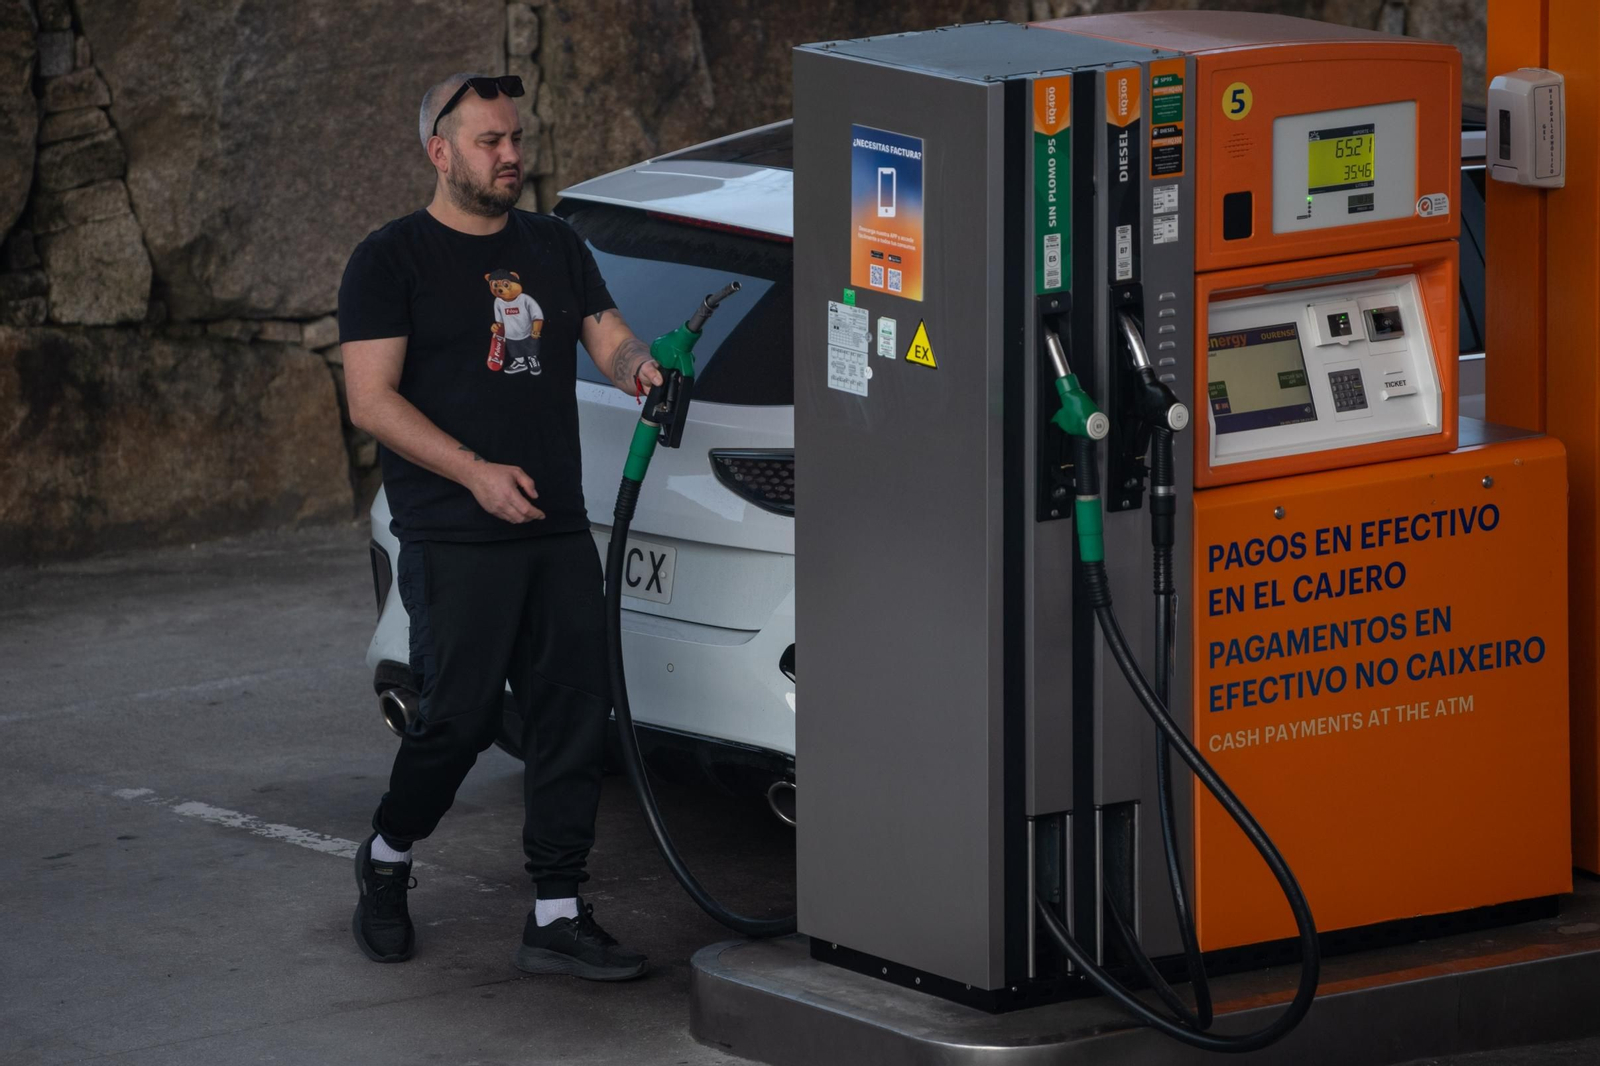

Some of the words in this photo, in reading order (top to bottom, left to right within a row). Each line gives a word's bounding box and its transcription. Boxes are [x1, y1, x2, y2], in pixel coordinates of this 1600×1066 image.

[1231, 89, 1246, 114] 5
[853, 138, 890, 153] ¿NECESITAS
[890, 146, 922, 160] FACTURA?
[1048, 138, 1056, 153] 95
[1119, 130, 1128, 182] DIESEL
[1048, 158, 1056, 202] PLOMO
[1048, 206, 1056, 227] SIN
[1048, 255, 1057, 263] E5
[1119, 246, 1128, 254] B7
[1207, 333, 1247, 349] nergy
[1261, 329, 1295, 340] OURENSE
[914, 345, 930, 362] EX
[1385, 380, 1406, 388] TICKET
[1208, 532, 1307, 572] PAGOS
[1315, 525, 1352, 556] EN
[1360, 504, 1500, 550] EFECTIVO
[1208, 585, 1245, 617] EN
[1254, 579, 1286, 610] EL
[1293, 561, 1406, 603] CAJERO
[1209, 613, 1407, 669] PAGAMENTOS
[1415, 606, 1452, 637] EN
[1209, 666, 1347, 713] EFECTIVO
[1356, 658, 1398, 690] NO
[1406, 636, 1546, 681] CAIXEIRO
[1208, 727, 1260, 752] CASH
[1265, 712, 1363, 744] PAYMENTS
[1367, 708, 1392, 728] AT
[1395, 702, 1430, 723] THE
[1435, 695, 1474, 716] ATM
